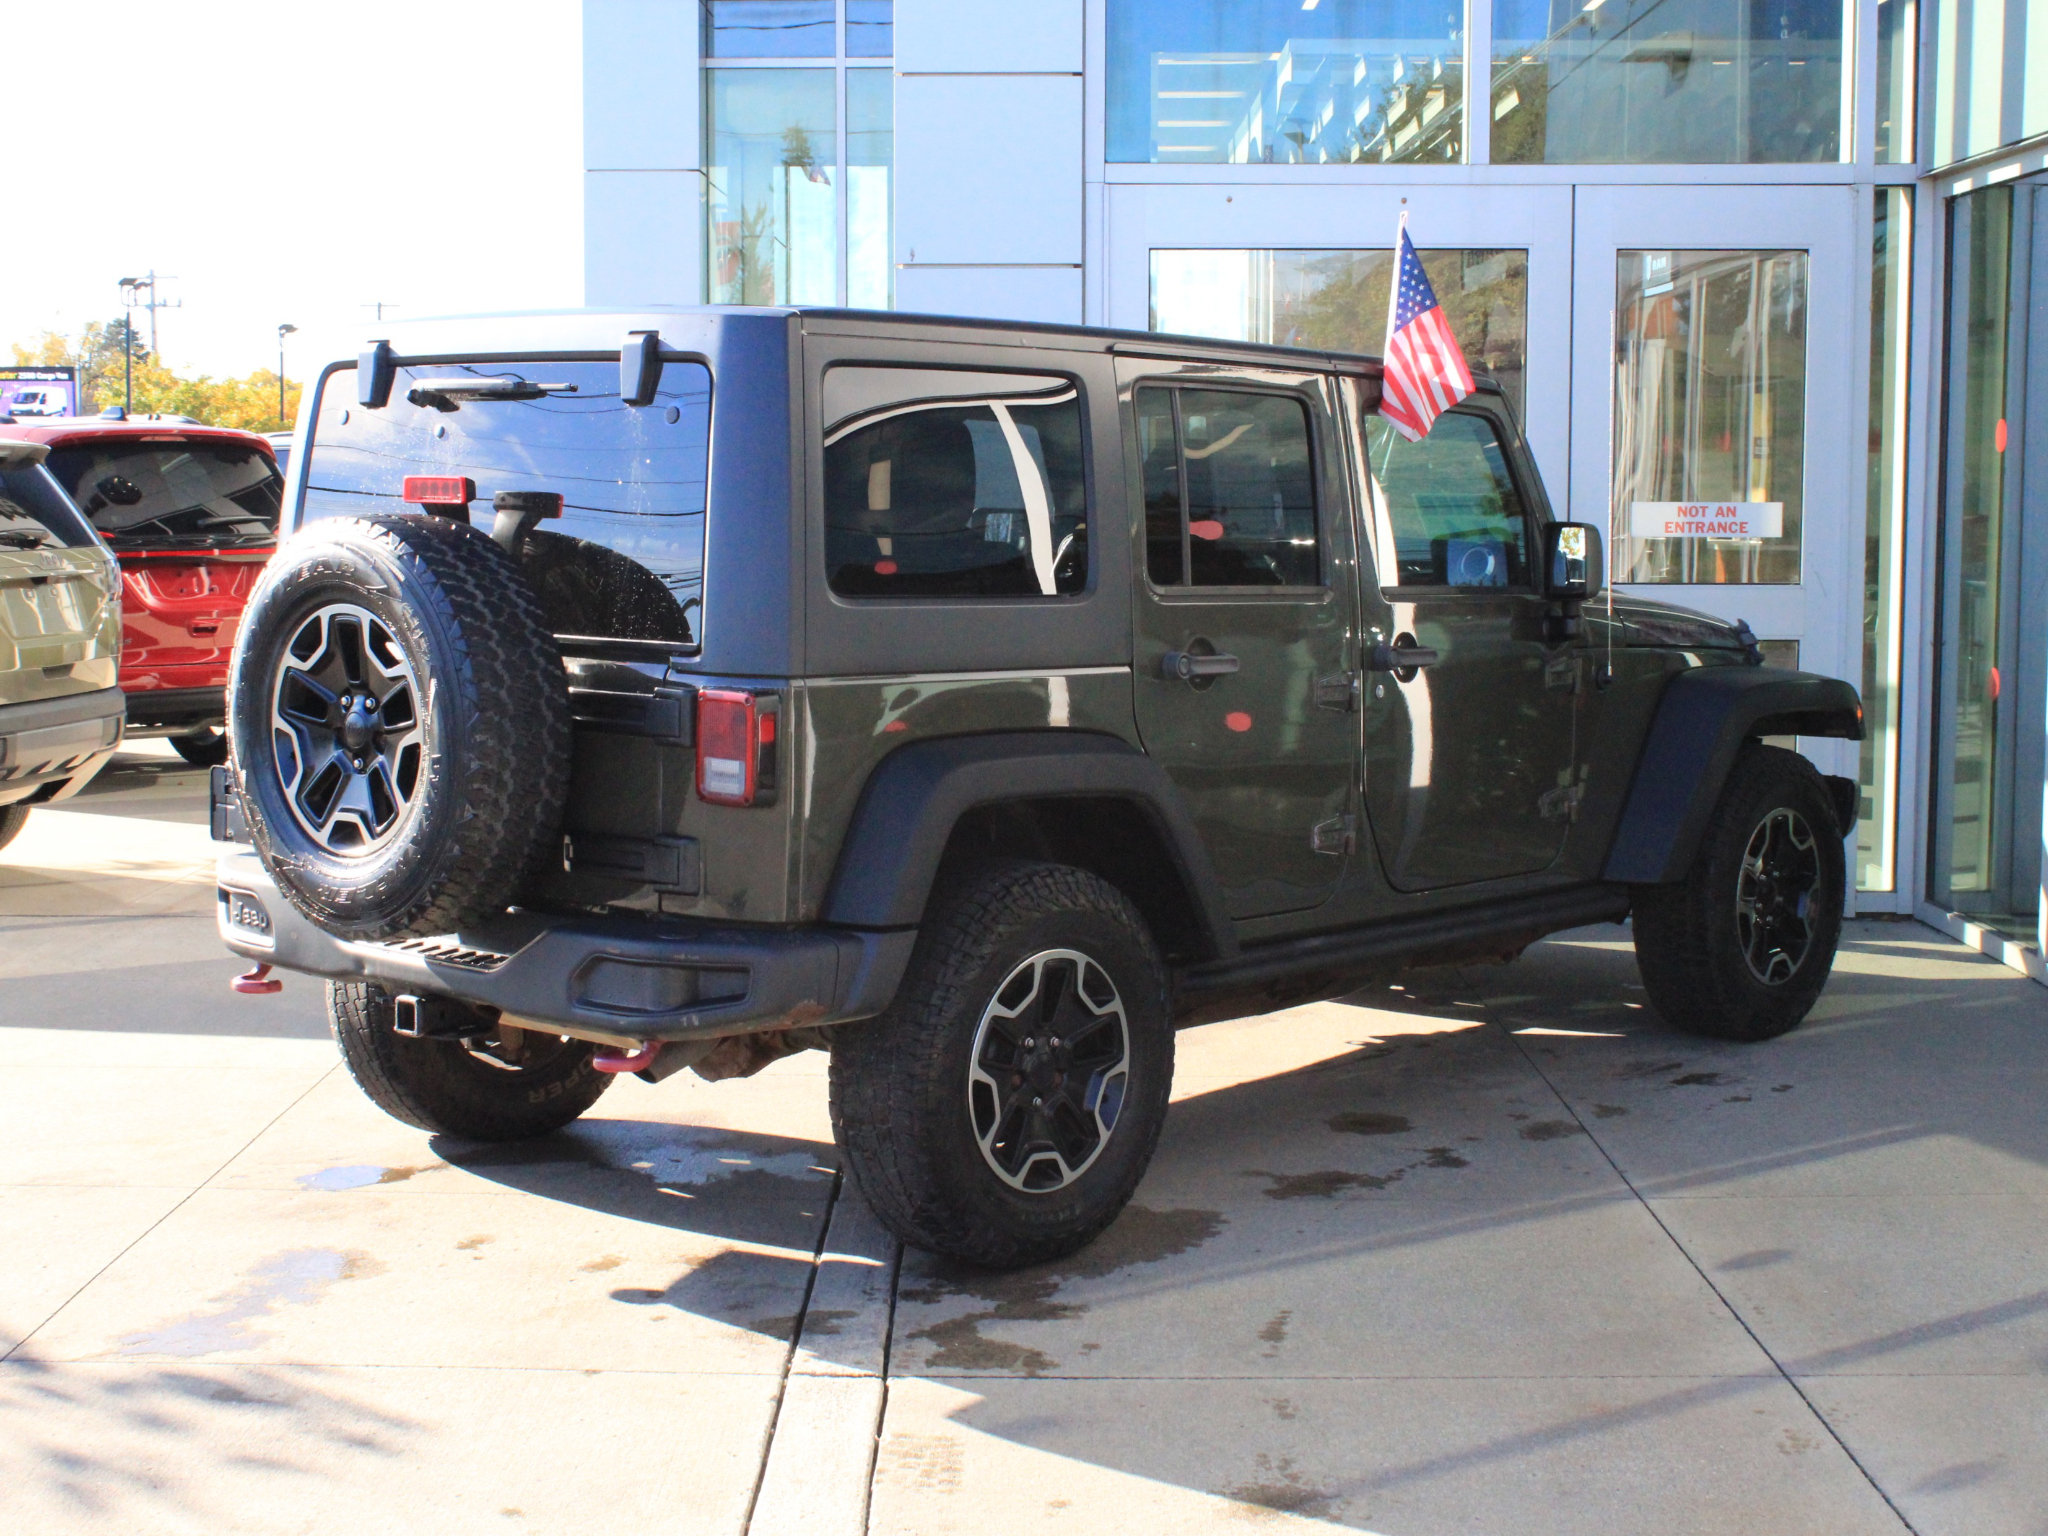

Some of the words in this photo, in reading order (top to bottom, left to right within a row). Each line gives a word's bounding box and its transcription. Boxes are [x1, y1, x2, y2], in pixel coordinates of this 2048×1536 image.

[1677, 505, 1708, 518] NOT
[1715, 505, 1737, 518] AN
[1664, 521, 1749, 534] ENTRANCE
[232, 901, 267, 931] Jeep
